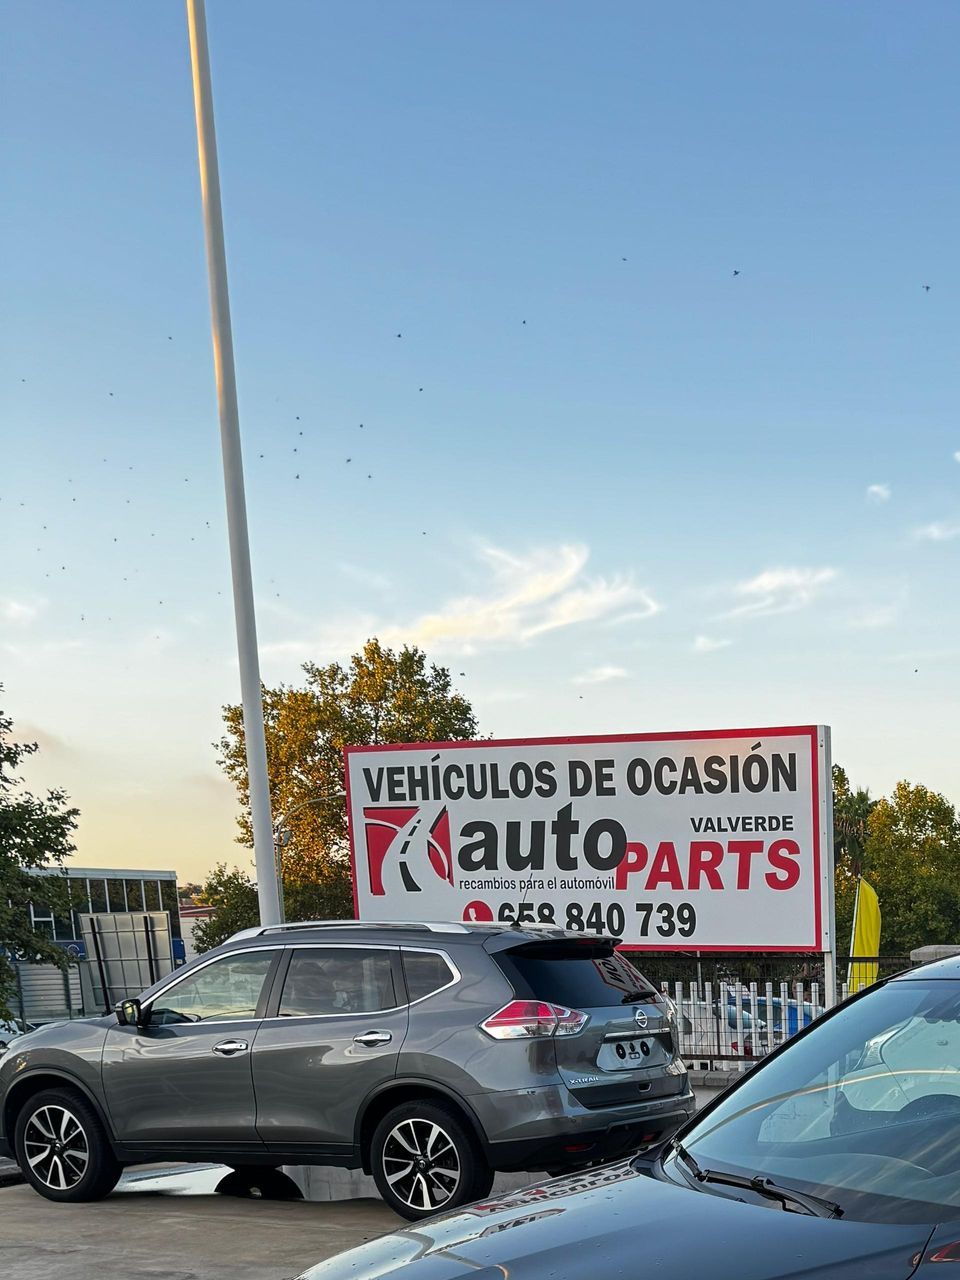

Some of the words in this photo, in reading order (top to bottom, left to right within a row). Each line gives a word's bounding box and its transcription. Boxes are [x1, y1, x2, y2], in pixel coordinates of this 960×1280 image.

[363, 753, 557, 802] VEHÍCULOS
[568, 759, 616, 797] DE
[627, 742, 797, 796] OCASIÓN
[690, 815, 794, 833] VALVERDE
[459, 876, 516, 890] recambios
[519, 878, 546, 892] para
[547, 876, 557, 890] el
[560, 875, 614, 890] automóvil
[566, 902, 626, 937] 840
[635, 902, 697, 938] 739
